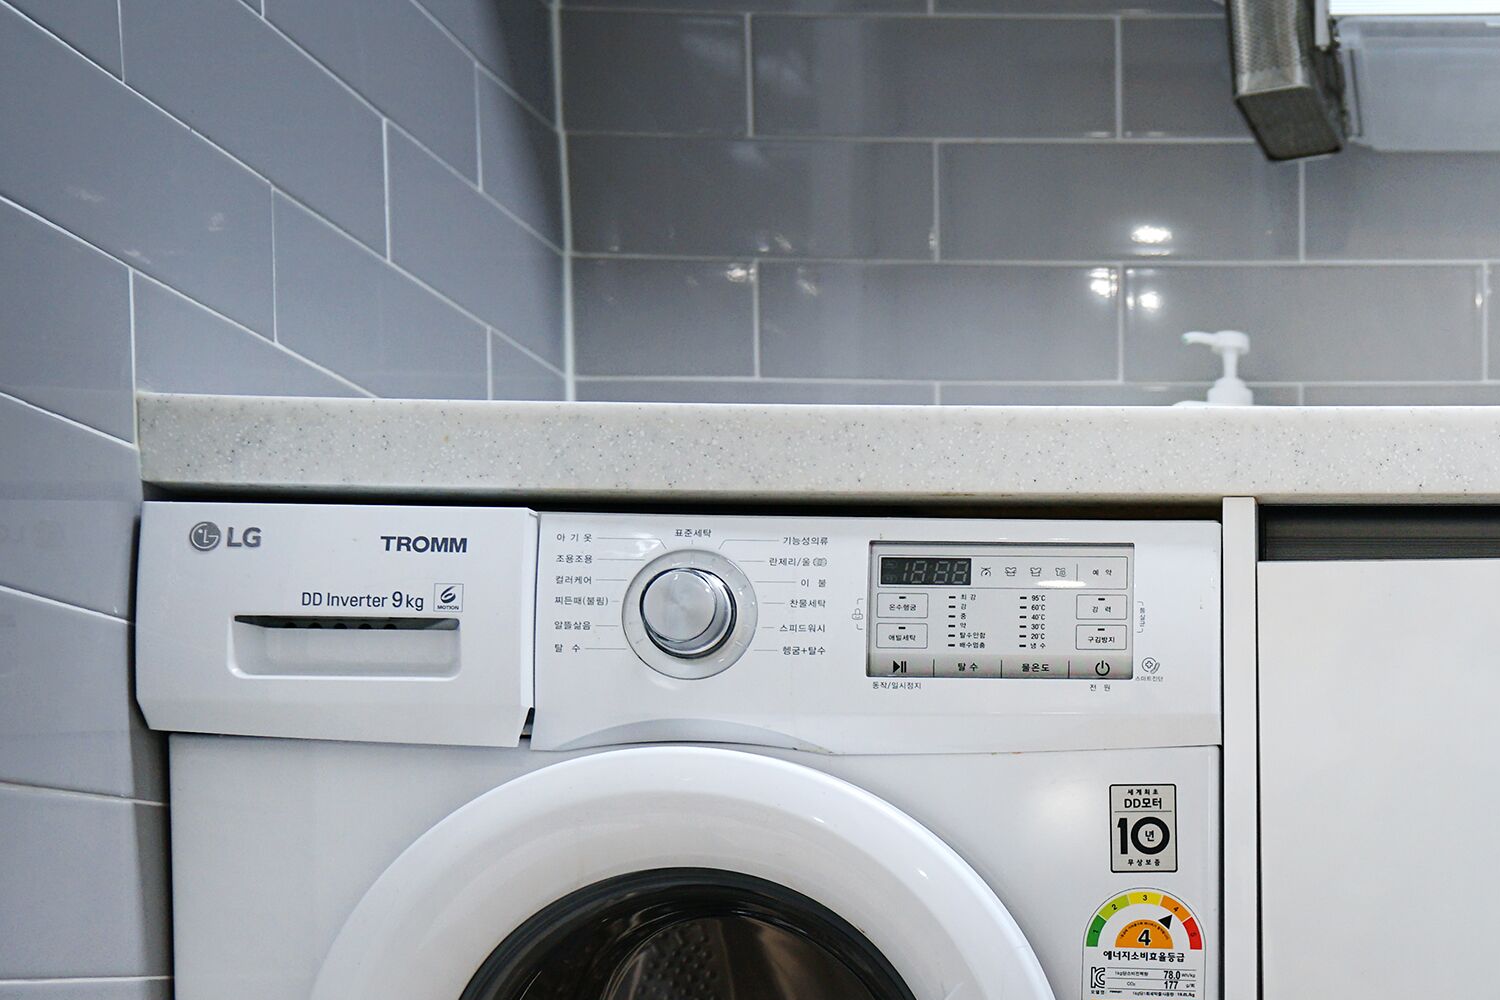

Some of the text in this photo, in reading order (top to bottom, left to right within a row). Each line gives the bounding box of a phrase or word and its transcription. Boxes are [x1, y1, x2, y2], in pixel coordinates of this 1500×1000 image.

[227, 527, 262, 548] LG
[675, 528, 712, 538] 표준세탁
[381, 535, 467, 553] TROMM
[783, 537, 828, 545] 기능성의류
[556, 555, 592, 563] 조용조용
[769, 558, 810, 566] 란제리/울
[555, 576, 592, 584] 컬러케어
[302, 592, 322, 607] DD
[327, 592, 388, 608] Inverter
[789, 599, 826, 608] 찬물세탁
[554, 621, 591, 630] 알뜰삶음
[779, 624, 826, 633] 스피드워시
[1021, 663, 1049, 673] 물온도
[872, 681, 922, 690] 동작/일시정지
[1124, 798, 1162, 809] DD모터
[1117, 816, 1170, 855] 10
[1145, 830, 1154, 842] 년
[1138, 929, 1151, 945] 4
[1103, 950, 1185, 962] 에너지소비효율등급
[1164, 971, 1180, 980] 78.0
[1164, 981, 1178, 989] 177
